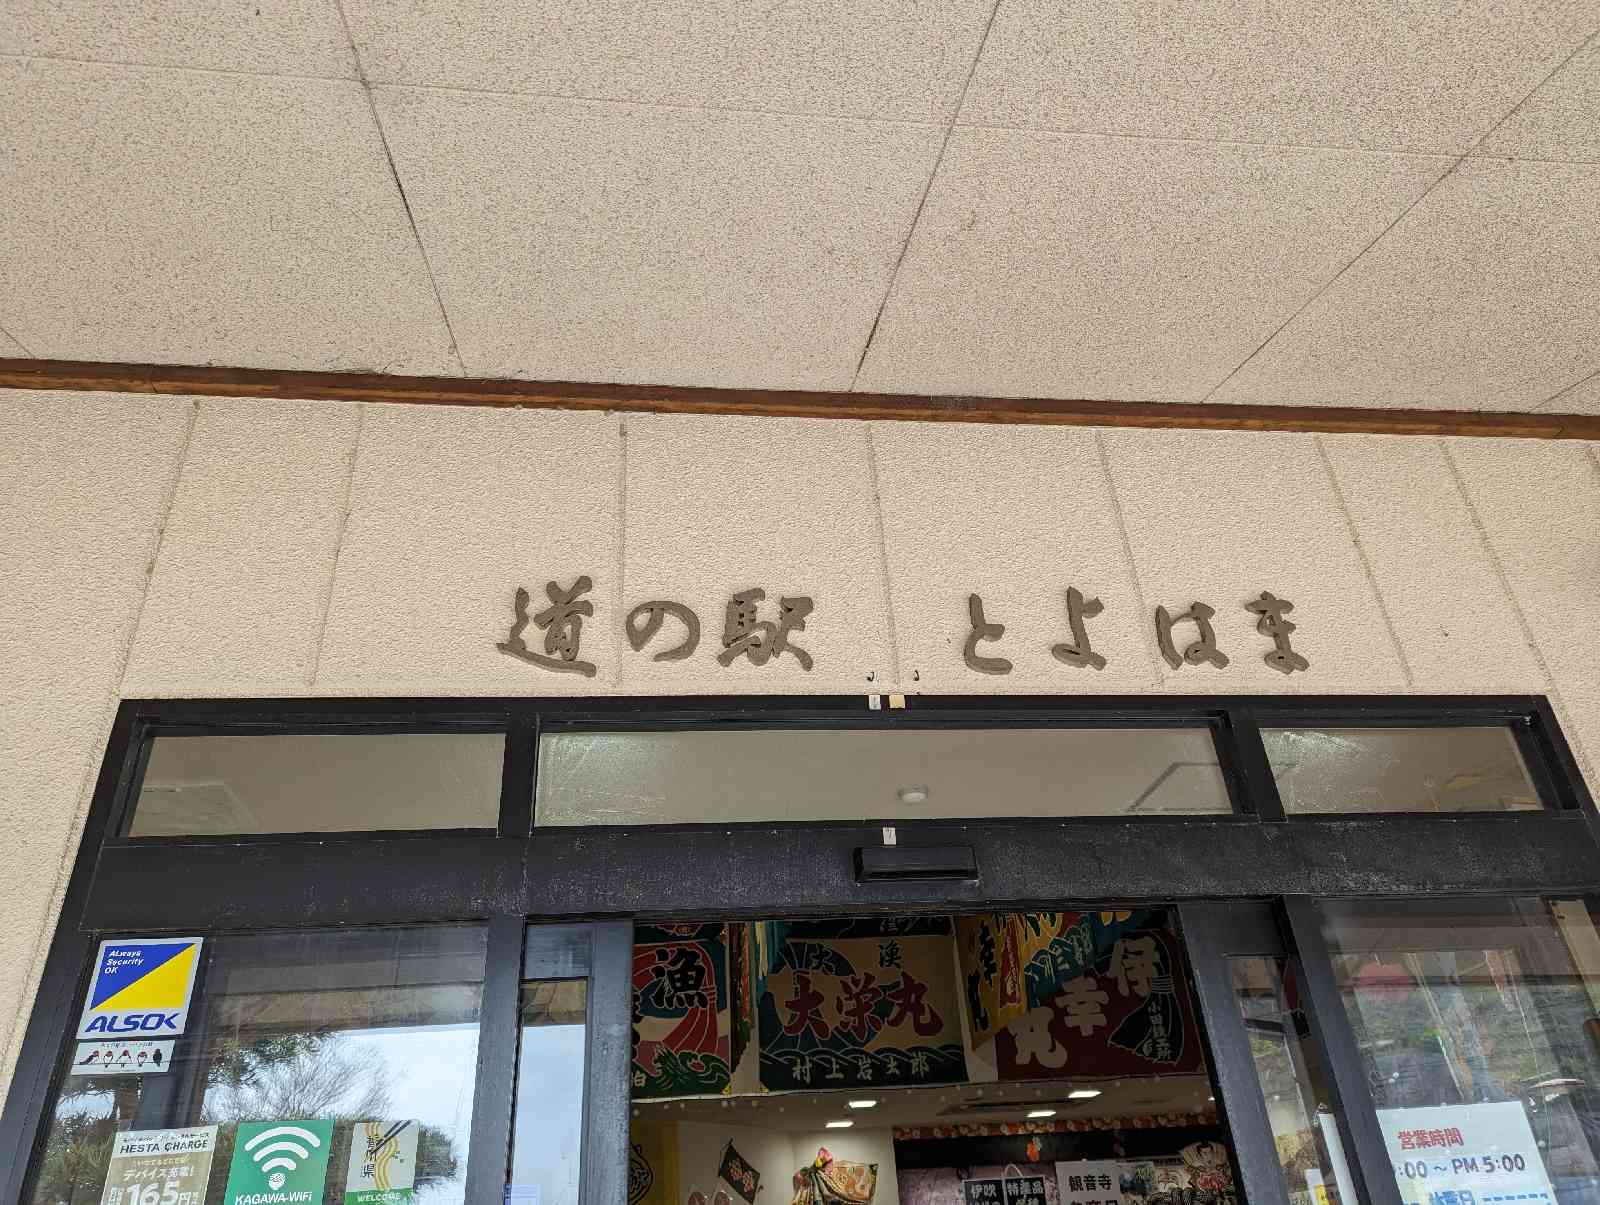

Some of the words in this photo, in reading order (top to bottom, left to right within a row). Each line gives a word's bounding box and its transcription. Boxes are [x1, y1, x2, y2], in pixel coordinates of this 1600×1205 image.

[496, 574, 814, 678] 道の駅
[963, 585, 1310, 675] とよはま
[104, 966, 118, 974] OK
[105, 957, 144, 967] Security
[85, 1011, 181, 1033] ALSOK
[120, 1143, 161, 1154] HESTA
[164, 1139, 209, 1152] CHARGE
[1398, 1127, 1465, 1150] 営業時間
[1393, 1160, 1428, 1179] :00
[1451, 1158, 1480, 1174] PM
[1482, 1153, 1526, 1173] 5:00
[1068, 1174, 1113, 1192] 観音寺
